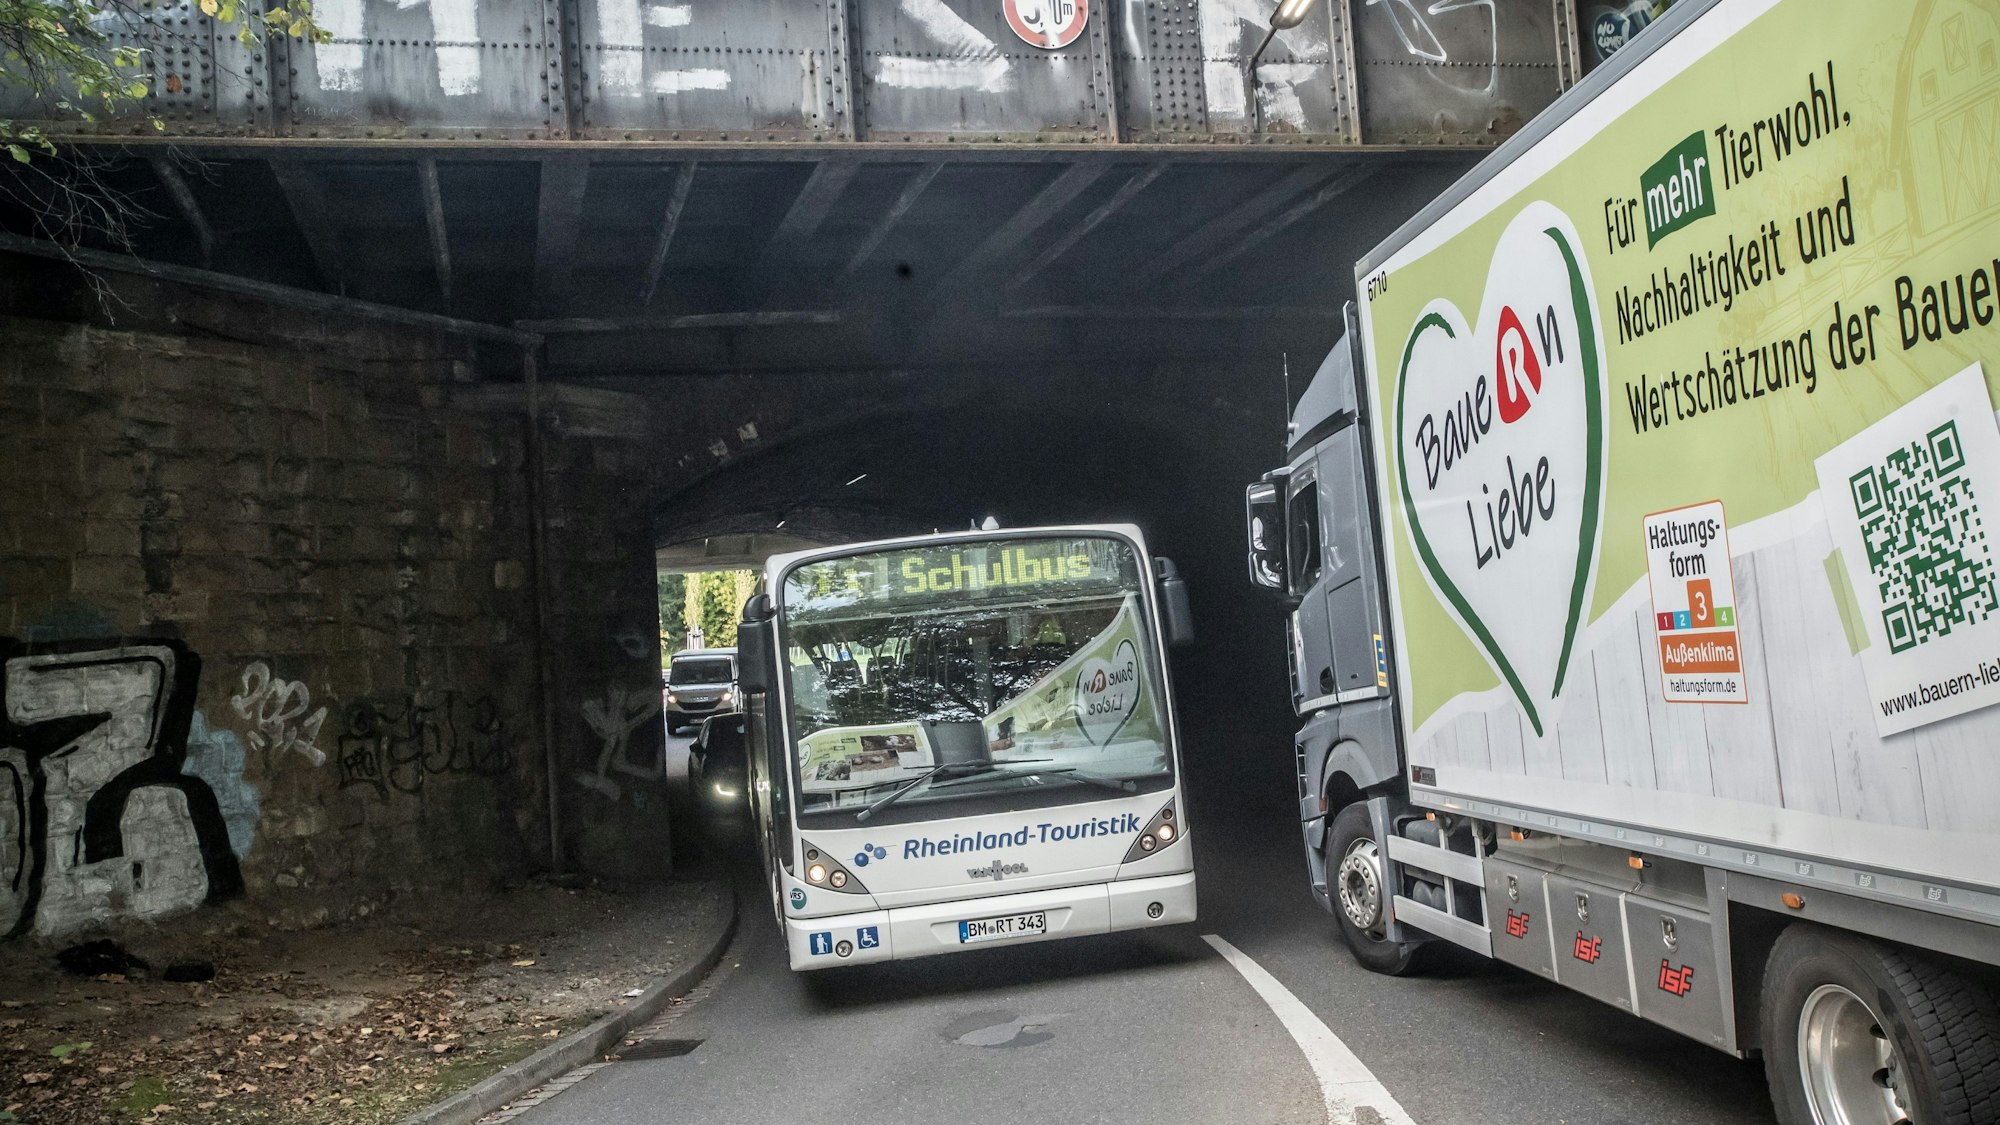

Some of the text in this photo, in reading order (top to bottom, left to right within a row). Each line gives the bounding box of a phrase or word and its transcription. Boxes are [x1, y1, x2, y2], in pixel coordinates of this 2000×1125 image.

[1604, 60, 1851, 255] Für mehr Tierwohl,
[1615, 175, 1855, 346] Nachhaltigkeit und
[1367, 270, 1388, 302] 6710
[1625, 328, 1817, 435] Wertschätzung
[1828, 301, 1881, 371] der
[1467, 455, 1556, 570] Liebe
[1649, 518, 1720, 550] Haltungs-
[901, 548, 1091, 594] Schulbus
[1669, 551, 1707, 578] form
[1663, 591, 1728, 628] 1 2 3 4
[1665, 642, 1735, 667] Außenklima
[1670, 678, 1737, 696] haltungsform.de
[1880, 657, 2000, 717] www.bauern-lie
[903, 813, 1141, 860] Rheinland-Touristik
[790, 891, 802, 900] VRS
[968, 922, 988, 937] BM
[995, 918, 1014, 934] RT
[1018, 914, 1044, 931] 343
[1505, 908, 1530, 939] isf
[1573, 930, 1602, 965] isf
[1658, 958, 1694, 998] isf
